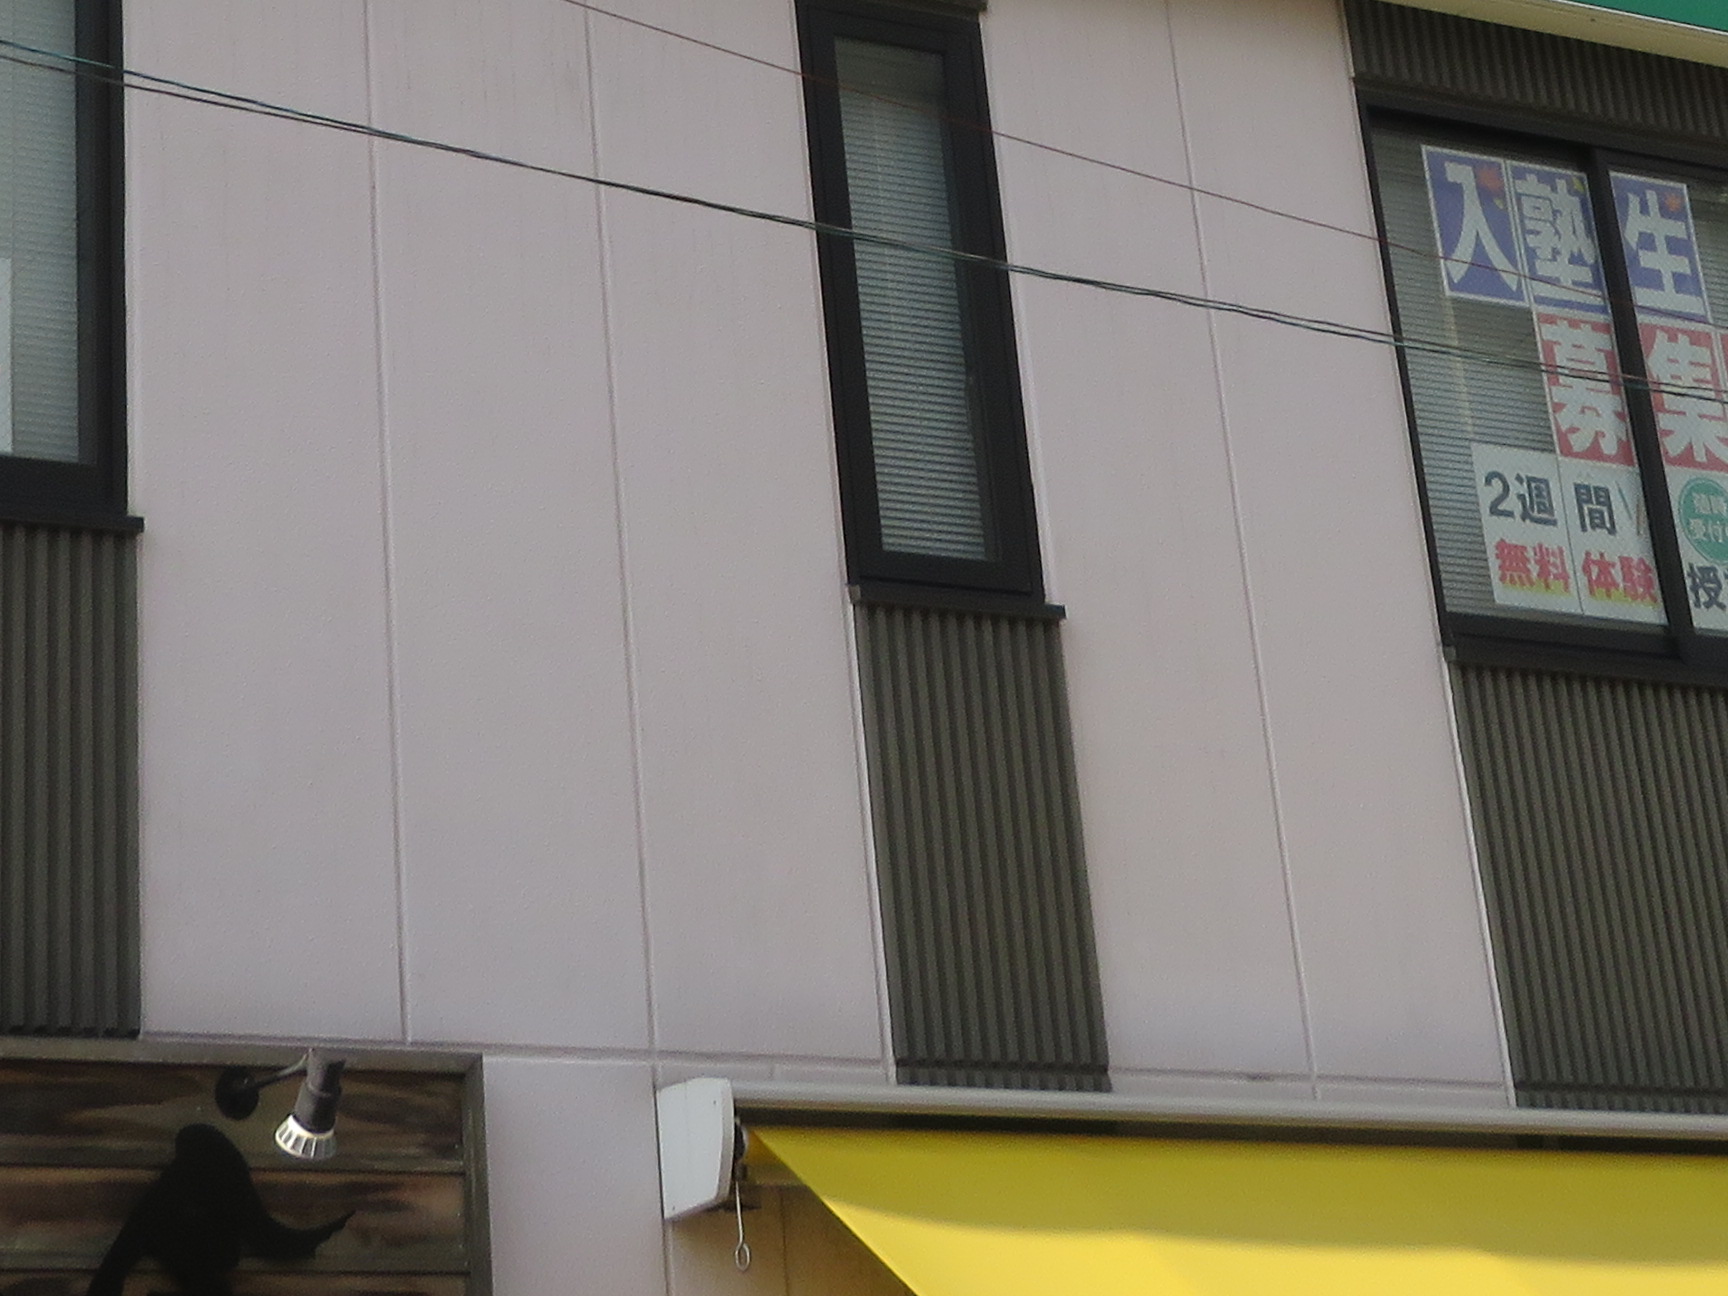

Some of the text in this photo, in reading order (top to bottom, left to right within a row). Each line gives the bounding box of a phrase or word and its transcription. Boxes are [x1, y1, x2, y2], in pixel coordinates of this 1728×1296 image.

[1444, 161, 1706, 317] 入塾生
[1484, 470, 1617, 536] 2週間
